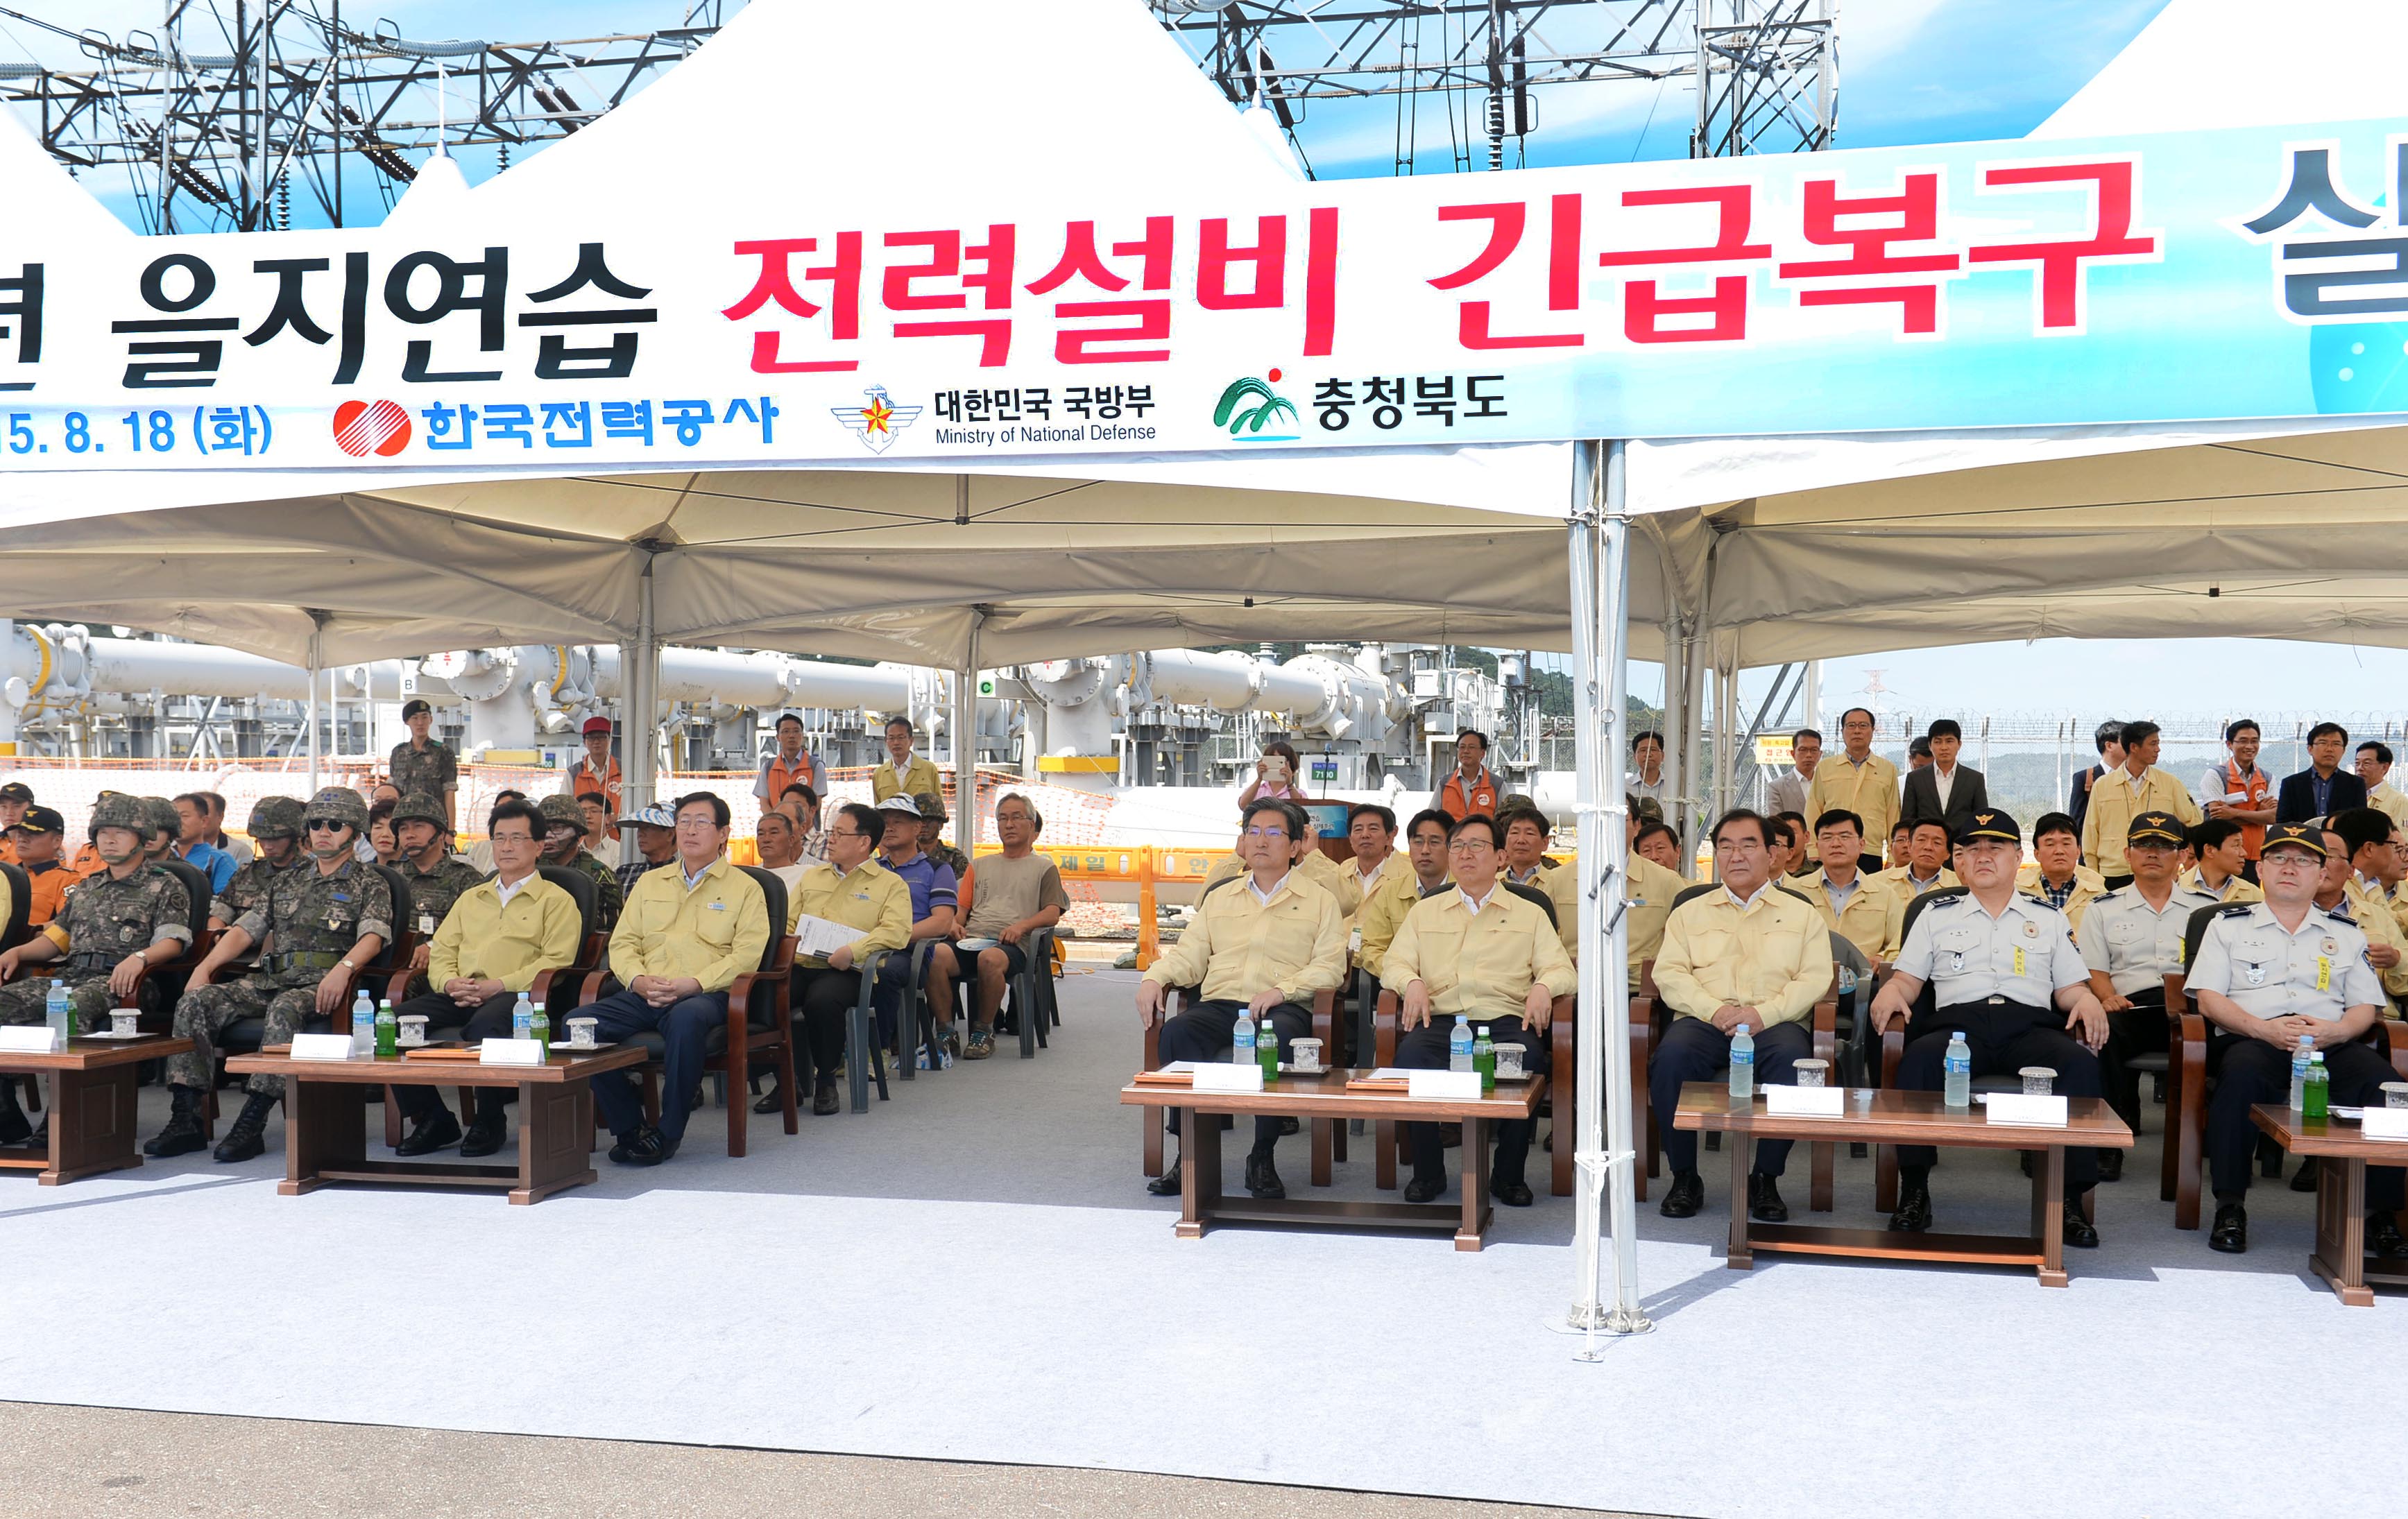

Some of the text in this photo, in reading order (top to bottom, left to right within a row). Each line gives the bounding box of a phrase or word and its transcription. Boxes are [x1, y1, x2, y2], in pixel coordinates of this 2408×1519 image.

[111, 242, 658, 389] 을지연습
[721, 207, 1339, 374] 전력설비
[1426, 162, 2155, 350] 긴급복구
[422, 396, 780, 451] 한국전력공사
[934, 385, 1155, 423] 대한민국 국방부
[1313, 375, 1508, 431] 충청북도
[65, 411, 104, 454] 8.
[123, 410, 176, 452] 18
[193, 404, 272, 456] (화)
[936, 424, 1156, 447] Ministry of National Defense
[405, 680, 412, 689] B
[981, 682, 991, 694] C
